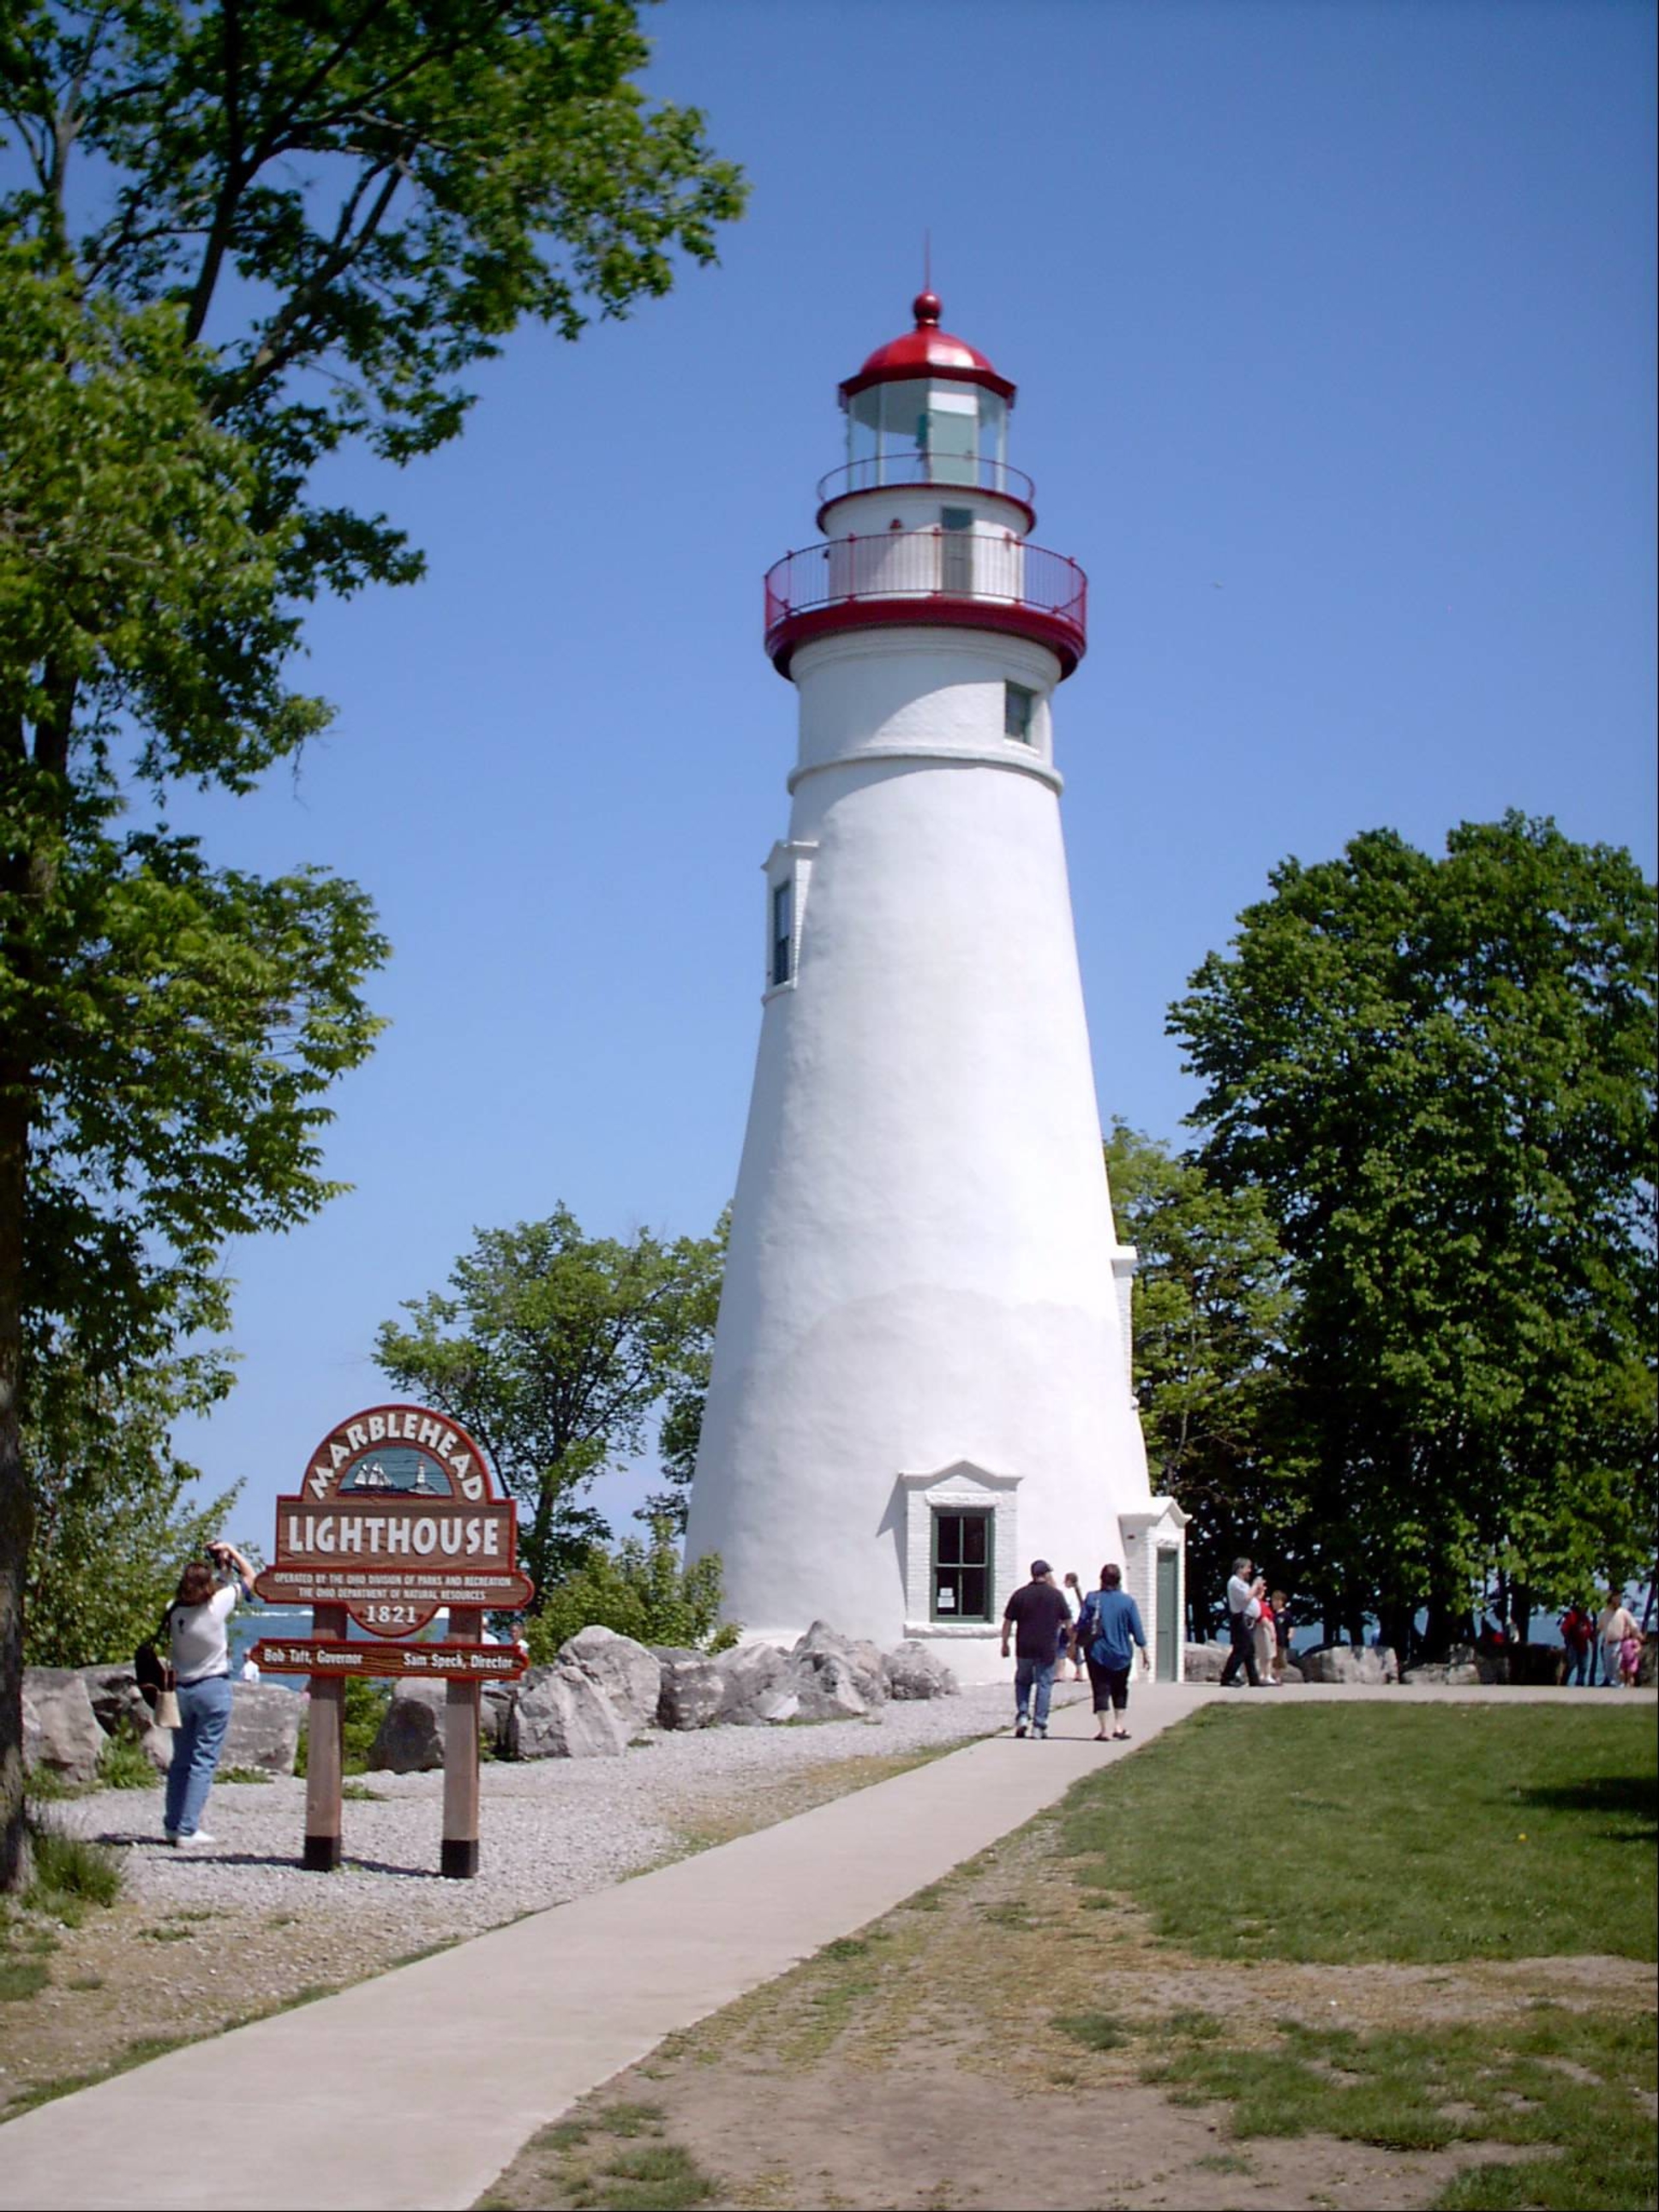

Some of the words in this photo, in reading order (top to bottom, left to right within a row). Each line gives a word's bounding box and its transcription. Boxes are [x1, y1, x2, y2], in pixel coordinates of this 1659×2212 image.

[308, 1412, 483, 1500] MARBLEHEAD
[288, 1515, 499, 1556] LIGHTHOUSE
[274, 1572, 313, 1584] OPERATED
[314, 1573, 326, 1584] BY
[329, 1574, 344, 1585] THE
[346, 1574, 367, 1585] OHIO
[368, 1574, 401, 1586] DIVISION
[404, 1574, 416, 1586] OF
[416, 1575, 443, 1586] PARKS
[445, 1575, 462, 1586] AND
[464, 1576, 512, 1586] RECREATION
[298, 1587, 313, 1598] THE
[315, 1587, 336, 1598] OHIO
[337, 1588, 386, 1599] DEPARTMENT
[390, 1589, 401, 1600] OF
[403, 1589, 438, 1601] NATURAL
[440, 1590, 486, 1601] RESOURCES
[366, 1605, 416, 1624] 1821
[263, 1647, 285, 1663] Bob
[289, 1648, 313, 1665] Taft,
[316, 1649, 363, 1665] Governor
[403, 1652, 428, 1666] Sam
[431, 1651, 467, 1669] Speck,
[470, 1653, 513, 1669] Director
